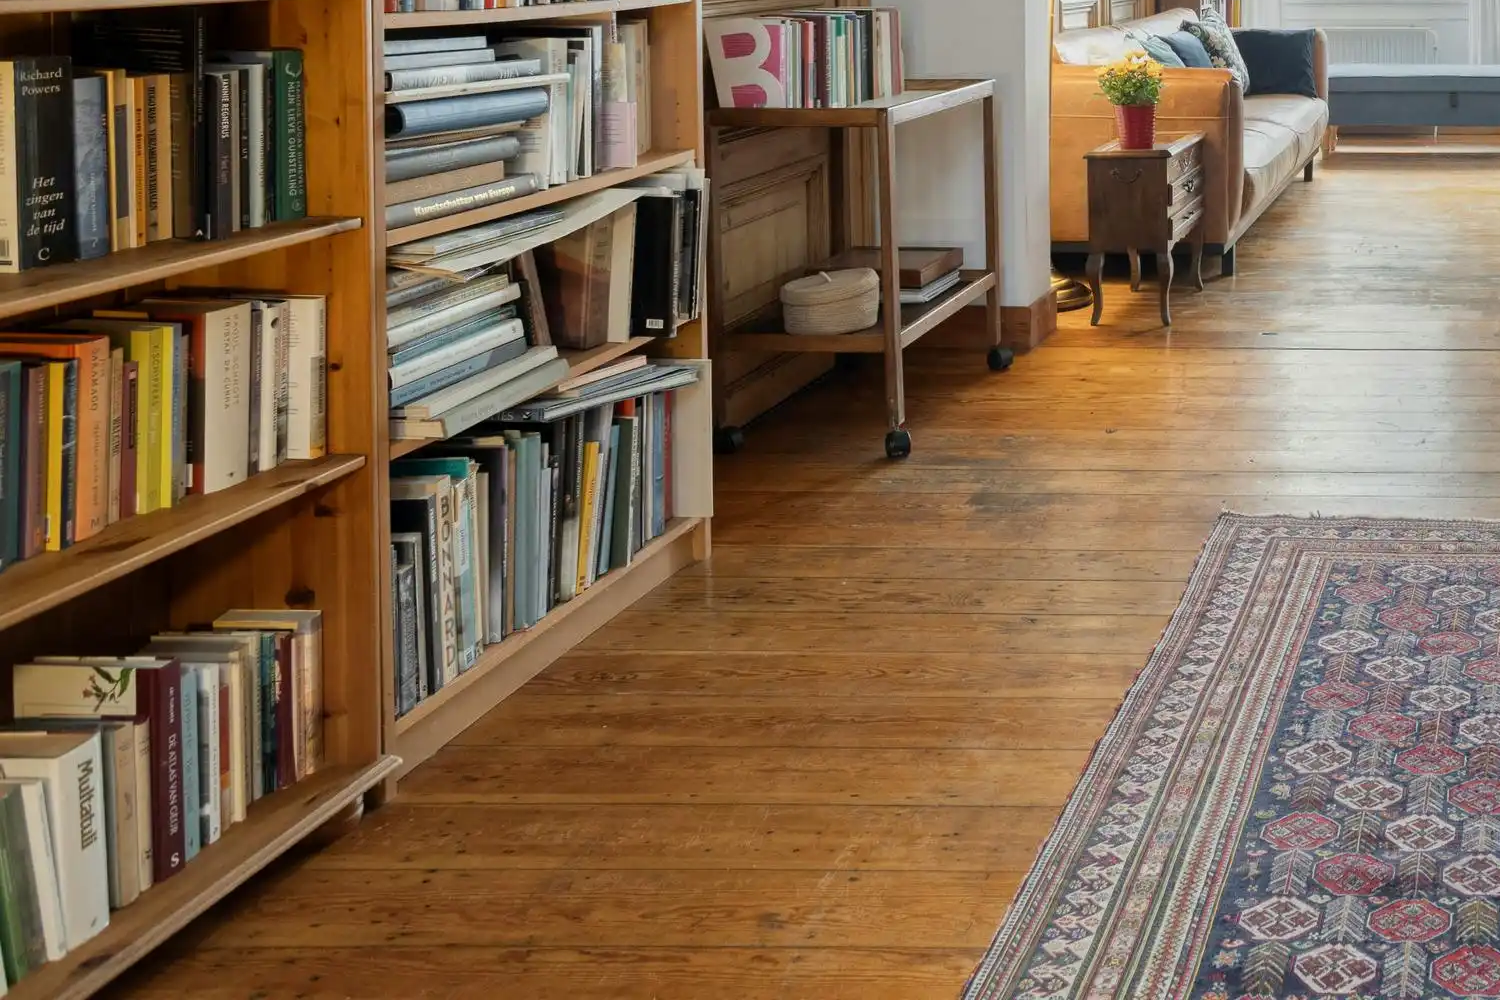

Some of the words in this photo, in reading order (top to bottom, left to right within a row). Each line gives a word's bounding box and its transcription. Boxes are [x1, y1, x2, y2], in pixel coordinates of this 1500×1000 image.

[19, 67, 63, 82] Richard
[21, 84, 61, 97] Powers
[220, 77, 231, 102] JANNIE
[220, 102, 231, 139] REGNERUS
[287, 107, 296, 134] LIEVE
[287, 136, 297, 197] GUNSTELING
[32, 176, 55, 190] Het
[25, 191, 65, 207] zingen
[413, 195, 474, 217] Kunstschatten
[488, 184, 516, 201] Europa
[26, 224, 40, 237] de
[43, 219, 65, 236] tijd
[33, 209, 56, 221] van
[222, 314, 232, 356] TRISTAN
[439, 494, 456, 668] BONNARD
[167, 750, 178, 781] ATLAS
[77, 757, 98, 852] Multatuli
